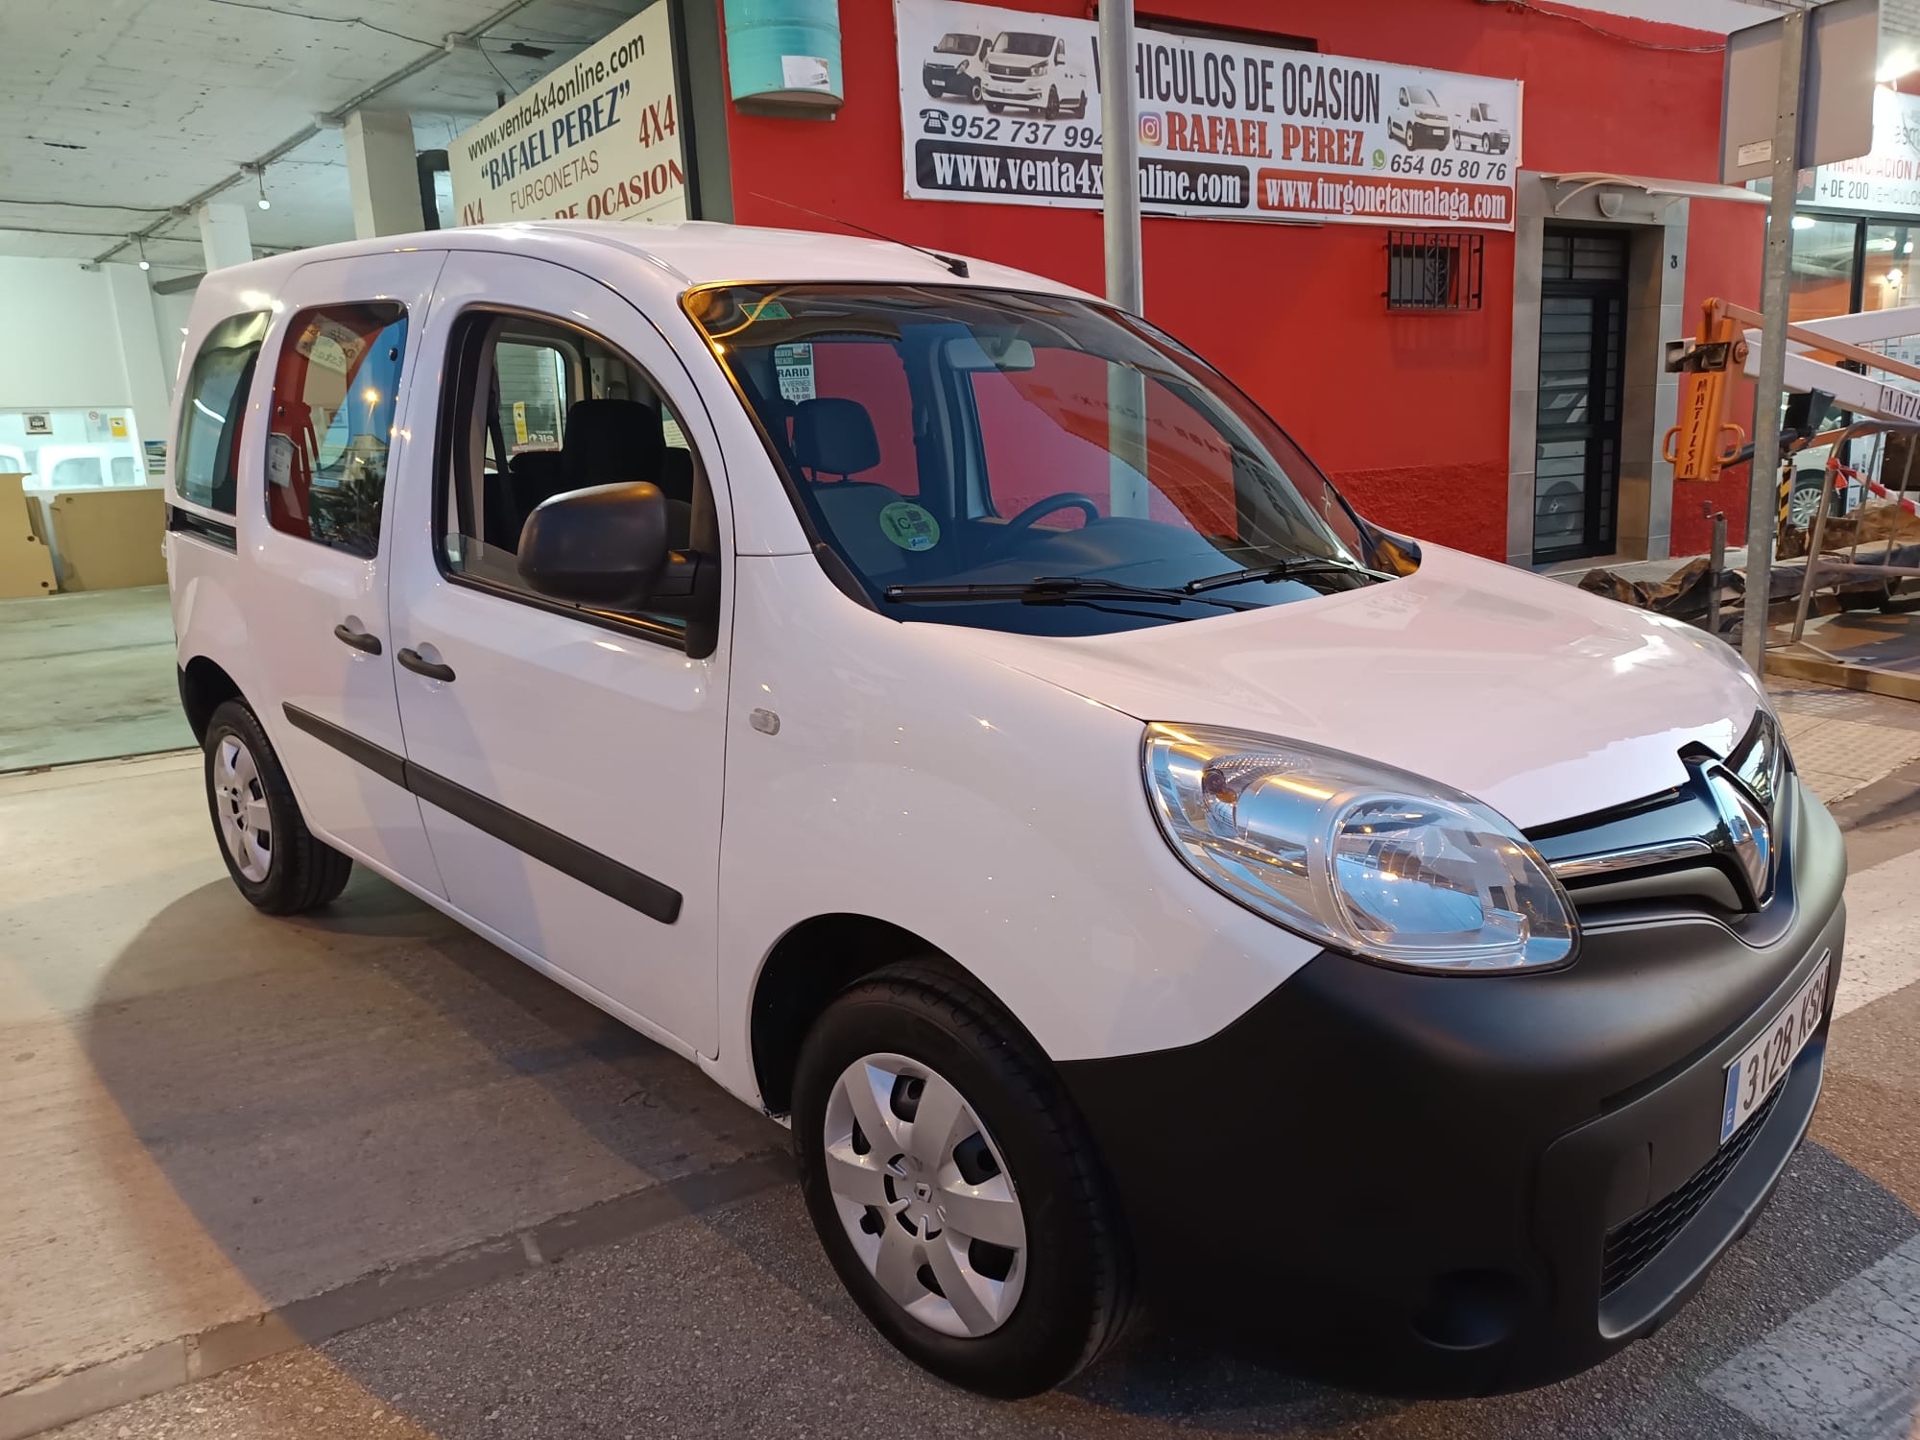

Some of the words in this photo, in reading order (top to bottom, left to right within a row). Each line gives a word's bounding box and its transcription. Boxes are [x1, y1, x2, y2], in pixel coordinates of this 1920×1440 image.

[468, 34, 645, 161] www.venta4x4online.com
[1091, 36, 1236, 109] HICULOS
[1243, 57, 1275, 114] DE
[1282, 61, 1380, 124] OCASION
[510, 149, 599, 214] FURGONETAS
[639, 94, 675, 149] 4X4
[951, 114, 1000, 141] 952
[1010, 120, 1056, 146] 737
[1166, 111, 1272, 159] RAFAEL
[1281, 123, 1364, 167] PEREZ
[587, 158, 684, 220] OCASION
[932, 152, 1241, 205] www.venta4xnline.com
[1390, 154, 1425, 175] 654
[1430, 157, 1452, 177] 05
[1458, 159, 1480, 180] 80
[1486, 161, 1507, 181] 76
[1831, 179, 1845, 199] DE
[1848, 181, 1870, 200] 200
[1266, 177, 1507, 221] www.furgonetasmalaga.com
[1671, 254, 1678, 270] 3
[777, 368, 810, 378] RARIO
[1684, 379, 1708, 476] MATILSA
[1743, 1013, 1793, 1111] 3128
